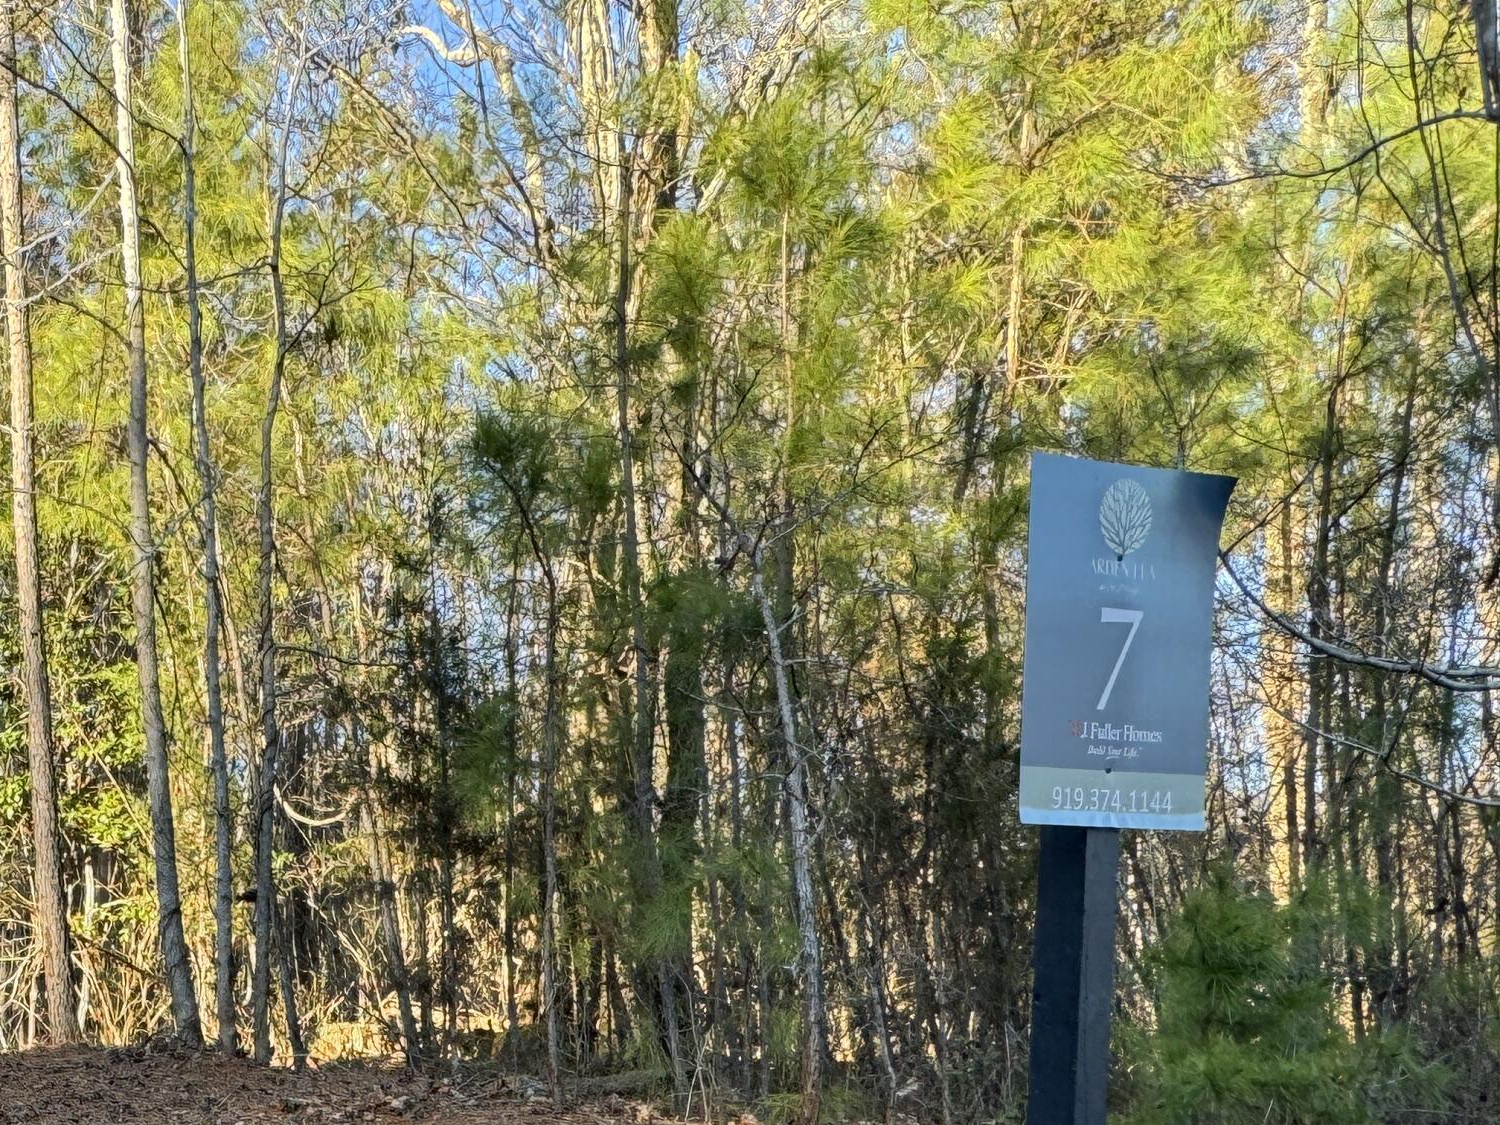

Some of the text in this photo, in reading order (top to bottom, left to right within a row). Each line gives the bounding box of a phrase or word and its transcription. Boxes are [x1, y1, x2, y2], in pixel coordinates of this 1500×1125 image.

[1096, 606, 1144, 711] 7
[1090, 722, 1123, 741] Fuller
[1123, 725, 1163, 742] Homes
[1051, 786, 1173, 814] 919.374.1144
